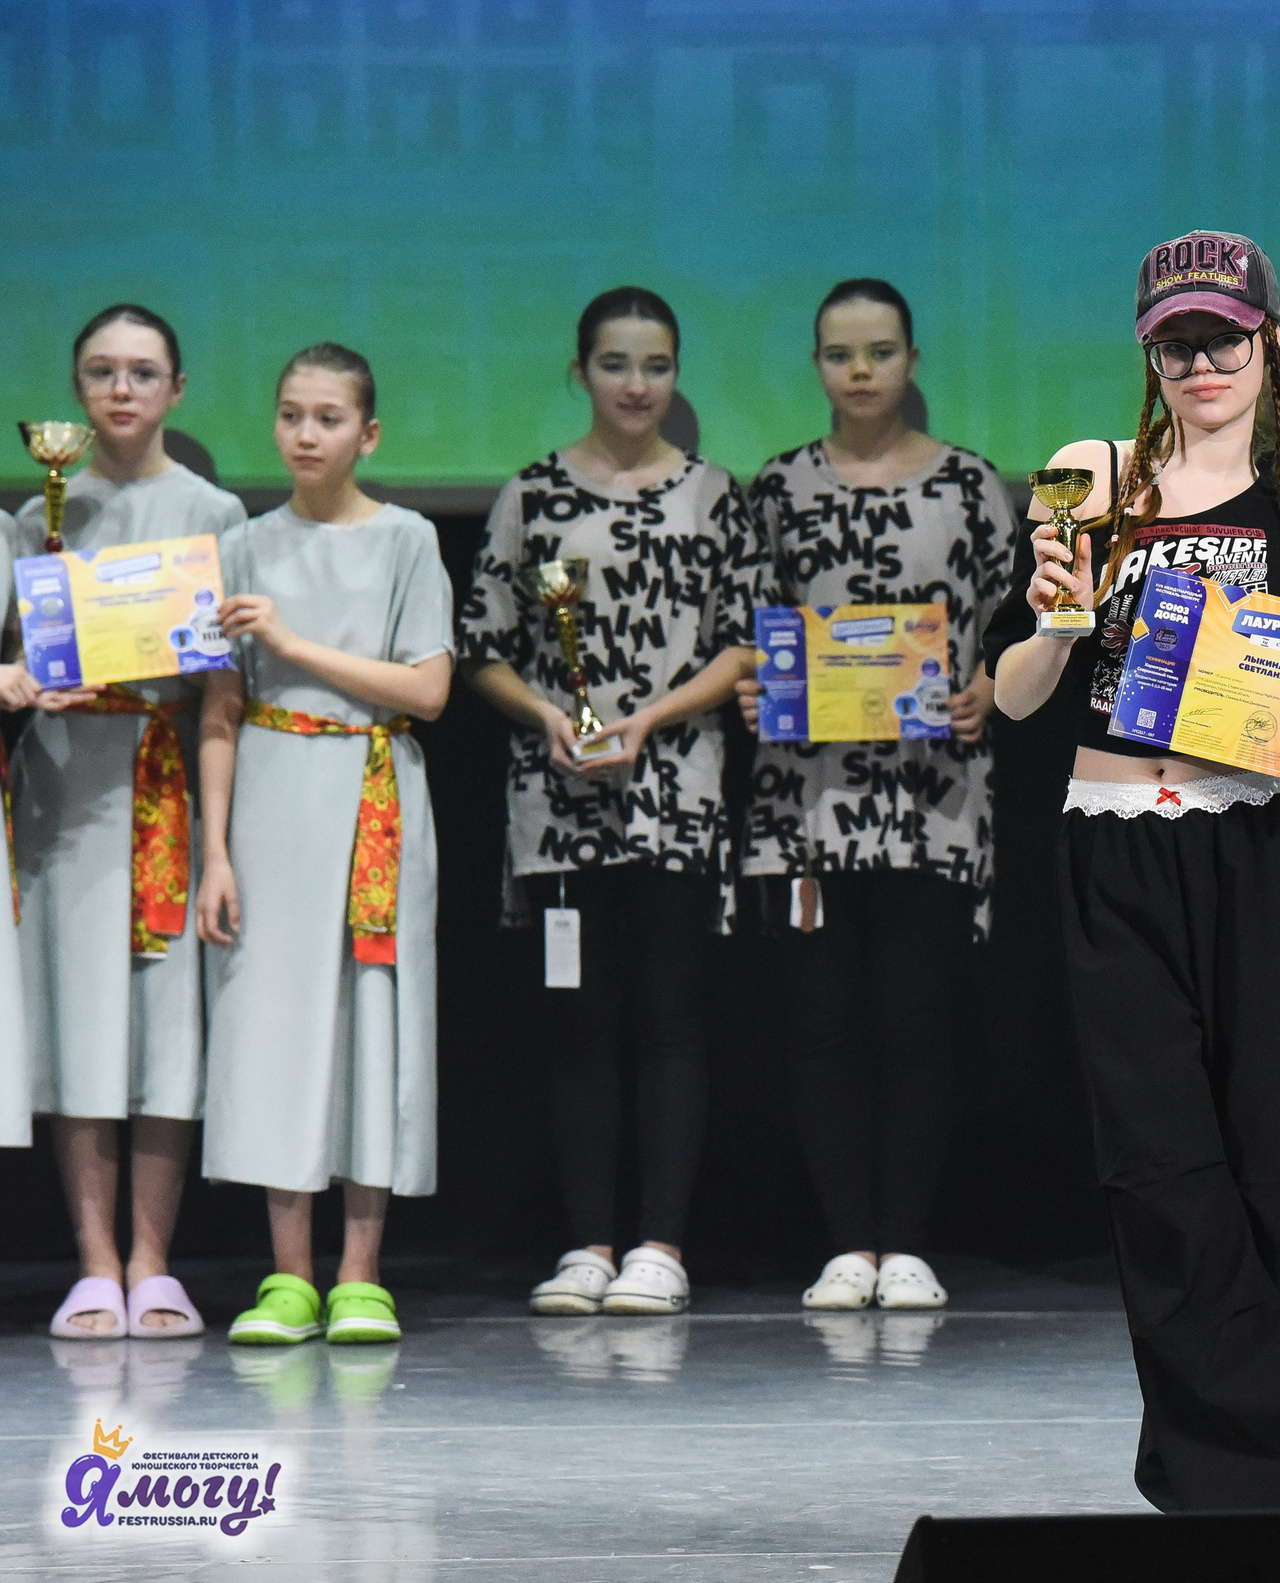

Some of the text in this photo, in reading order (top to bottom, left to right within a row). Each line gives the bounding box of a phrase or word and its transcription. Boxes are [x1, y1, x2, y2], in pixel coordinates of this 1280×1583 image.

[1154, 238, 1241, 281] ROCK
[1156, 272, 1239, 288] SHOW FEATURES
[1159, 600, 1190, 615] СОЮЗ
[1153, 609, 1189, 625] ДОБРА
